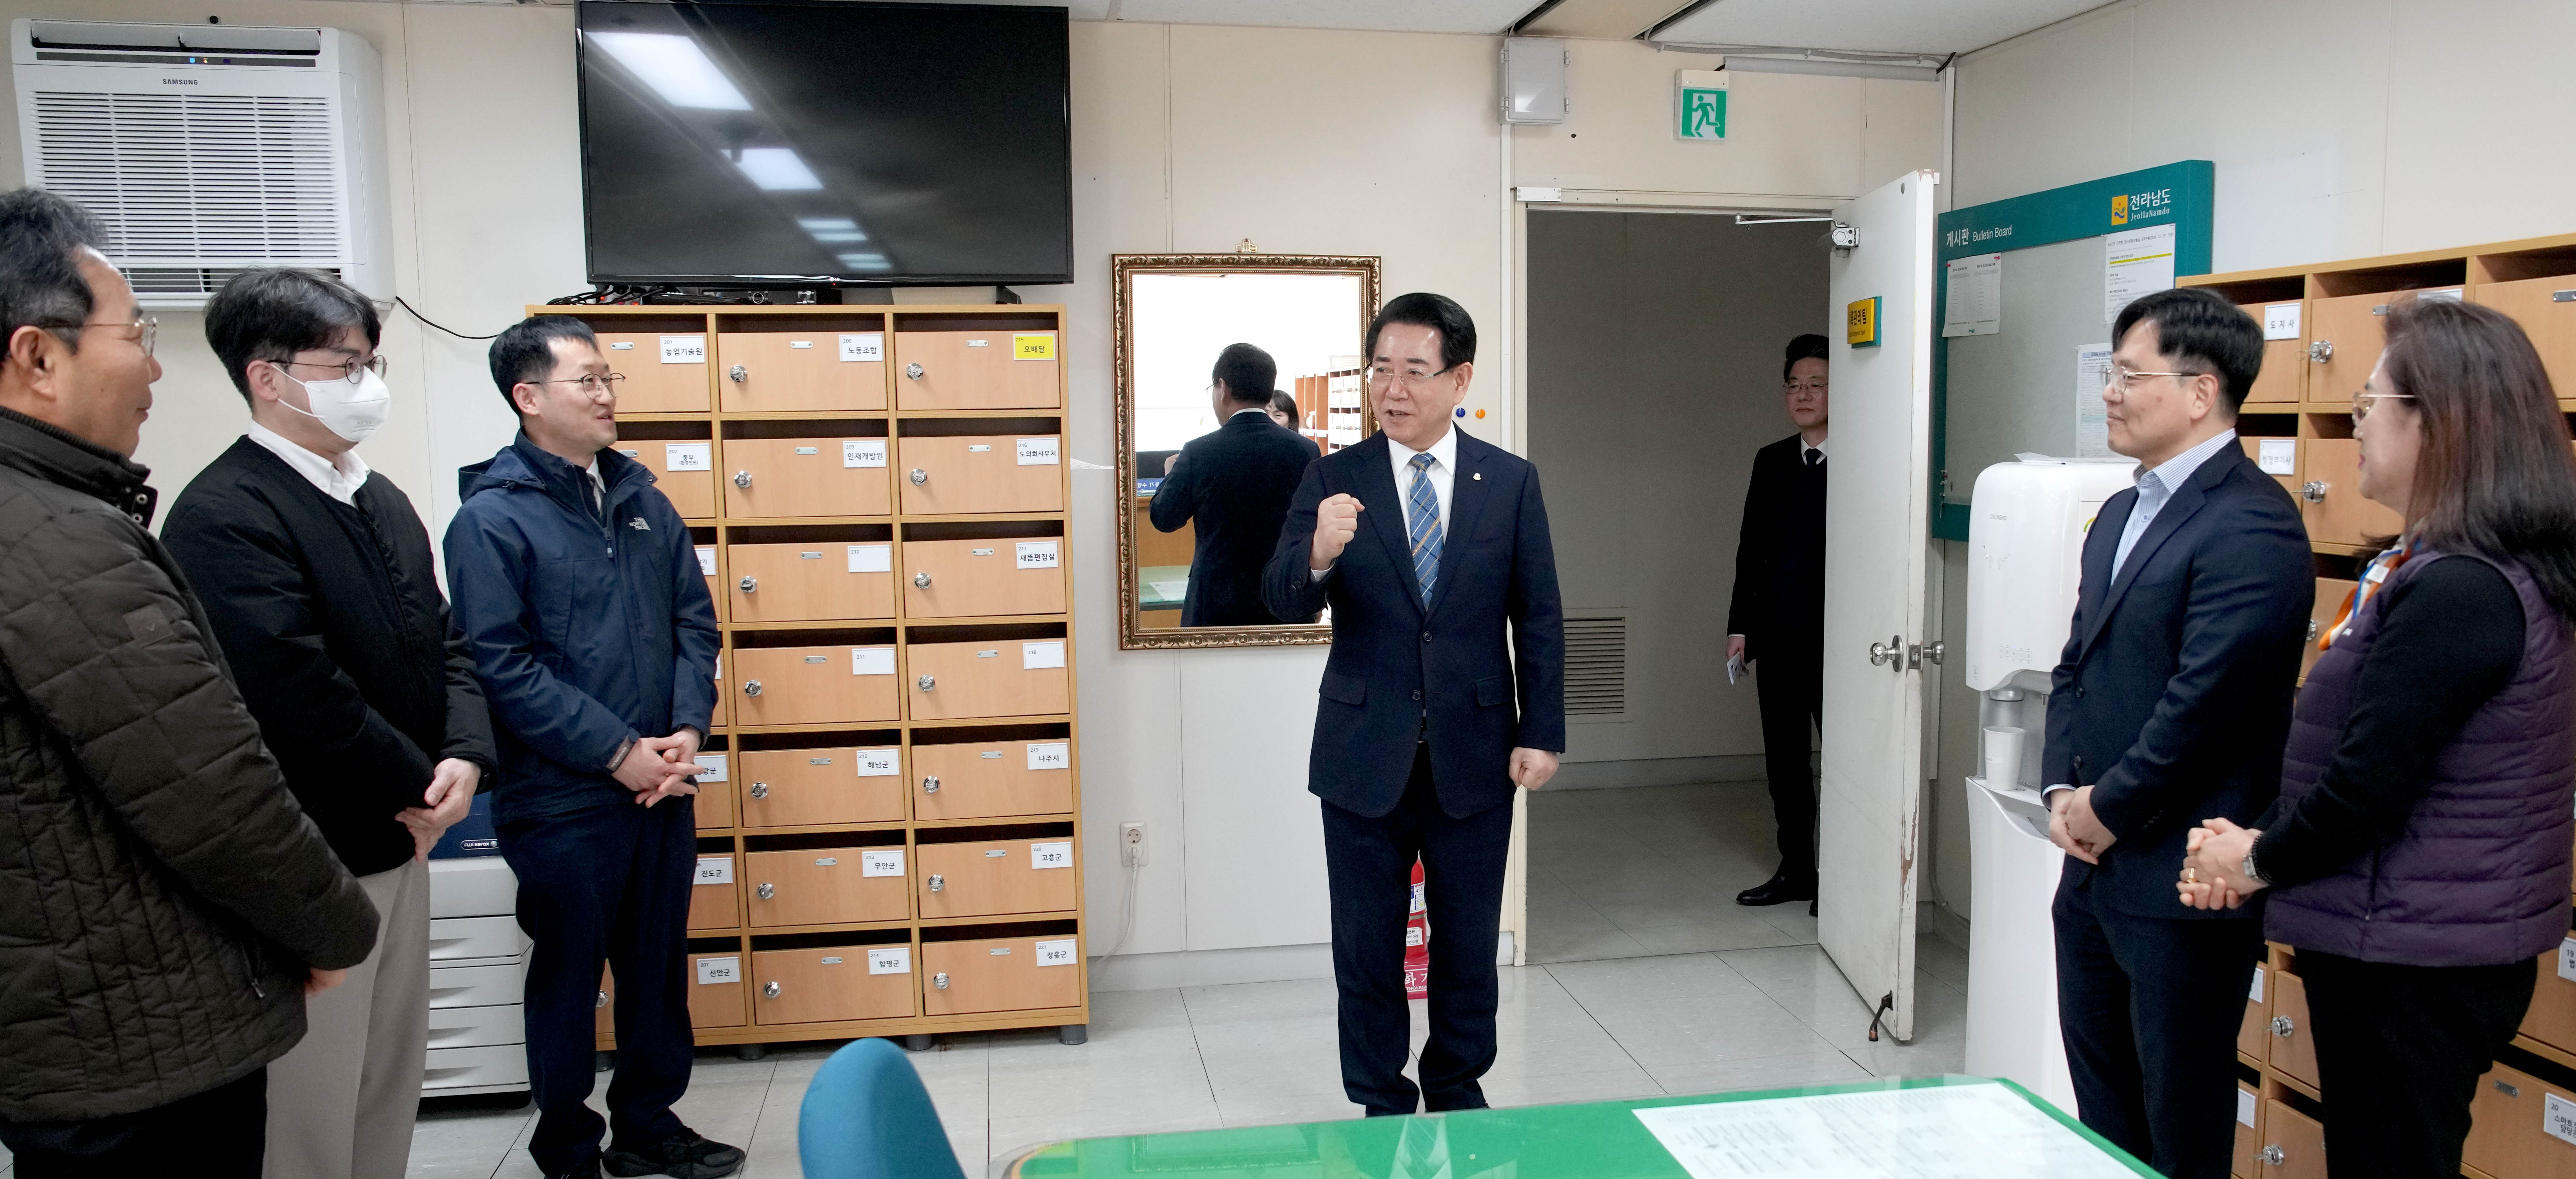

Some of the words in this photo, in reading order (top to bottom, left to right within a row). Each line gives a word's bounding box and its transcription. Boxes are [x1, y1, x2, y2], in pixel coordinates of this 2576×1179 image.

[2130, 188, 2171, 210] 전라남도
[2131, 207, 2170, 221] JeollaNamdo
[1947, 228, 1969, 247] 게시판
[1973, 229, 1993, 242] Bulletin
[1995, 225, 2012, 238] Board
[666, 348, 703, 356] 농업기술원
[848, 347, 877, 355] 노동조합
[847, 452, 883, 460] 인재개발원
[1020, 553, 1054, 561] 새뜸편집실
[710, 969, 730, 977] 신안군
[2551, 1103, 2559, 1111] 20
